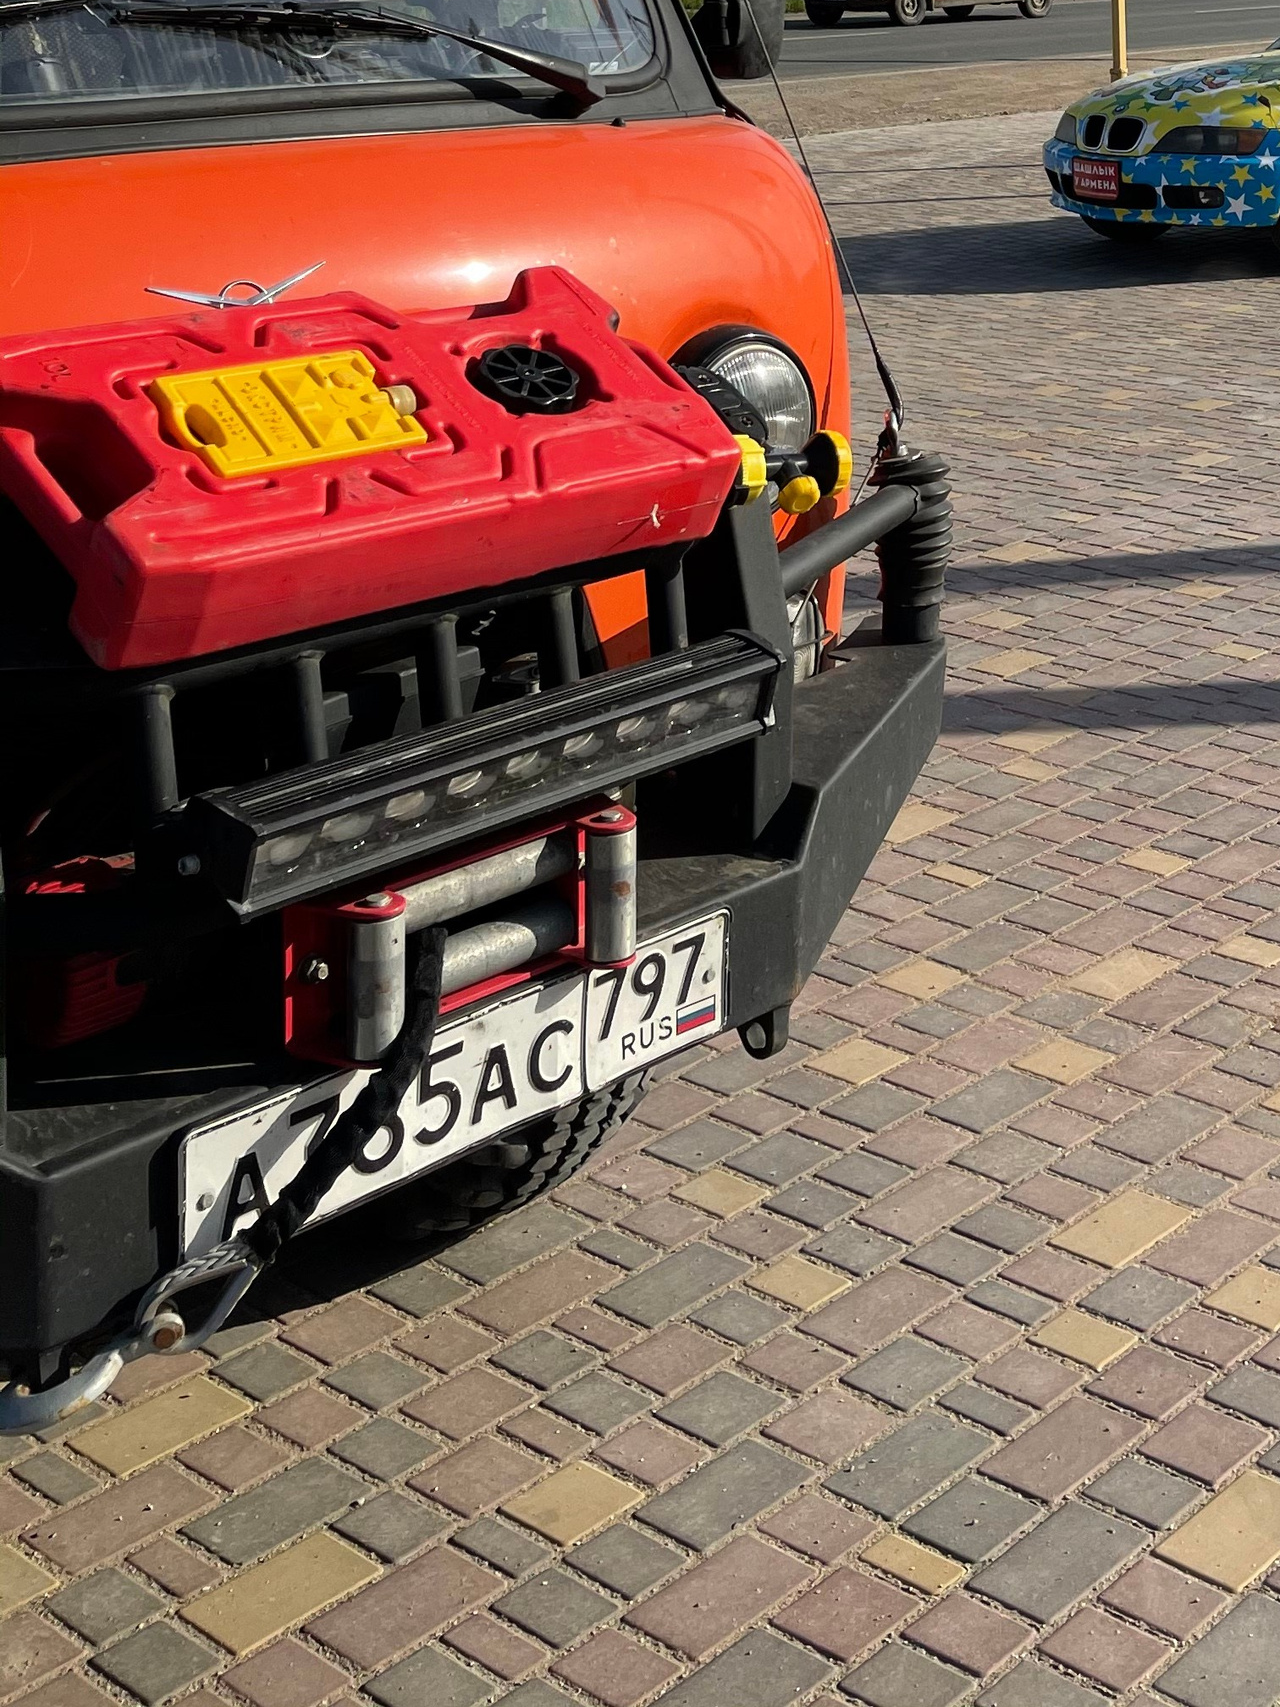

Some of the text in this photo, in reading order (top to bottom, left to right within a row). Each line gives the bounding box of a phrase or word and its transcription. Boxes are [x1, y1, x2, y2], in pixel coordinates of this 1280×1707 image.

[1073, 161, 1116, 176] ШАШЛЫК
[593, 932, 706, 1041] 797
[621, 1016, 674, 1062] RUS
